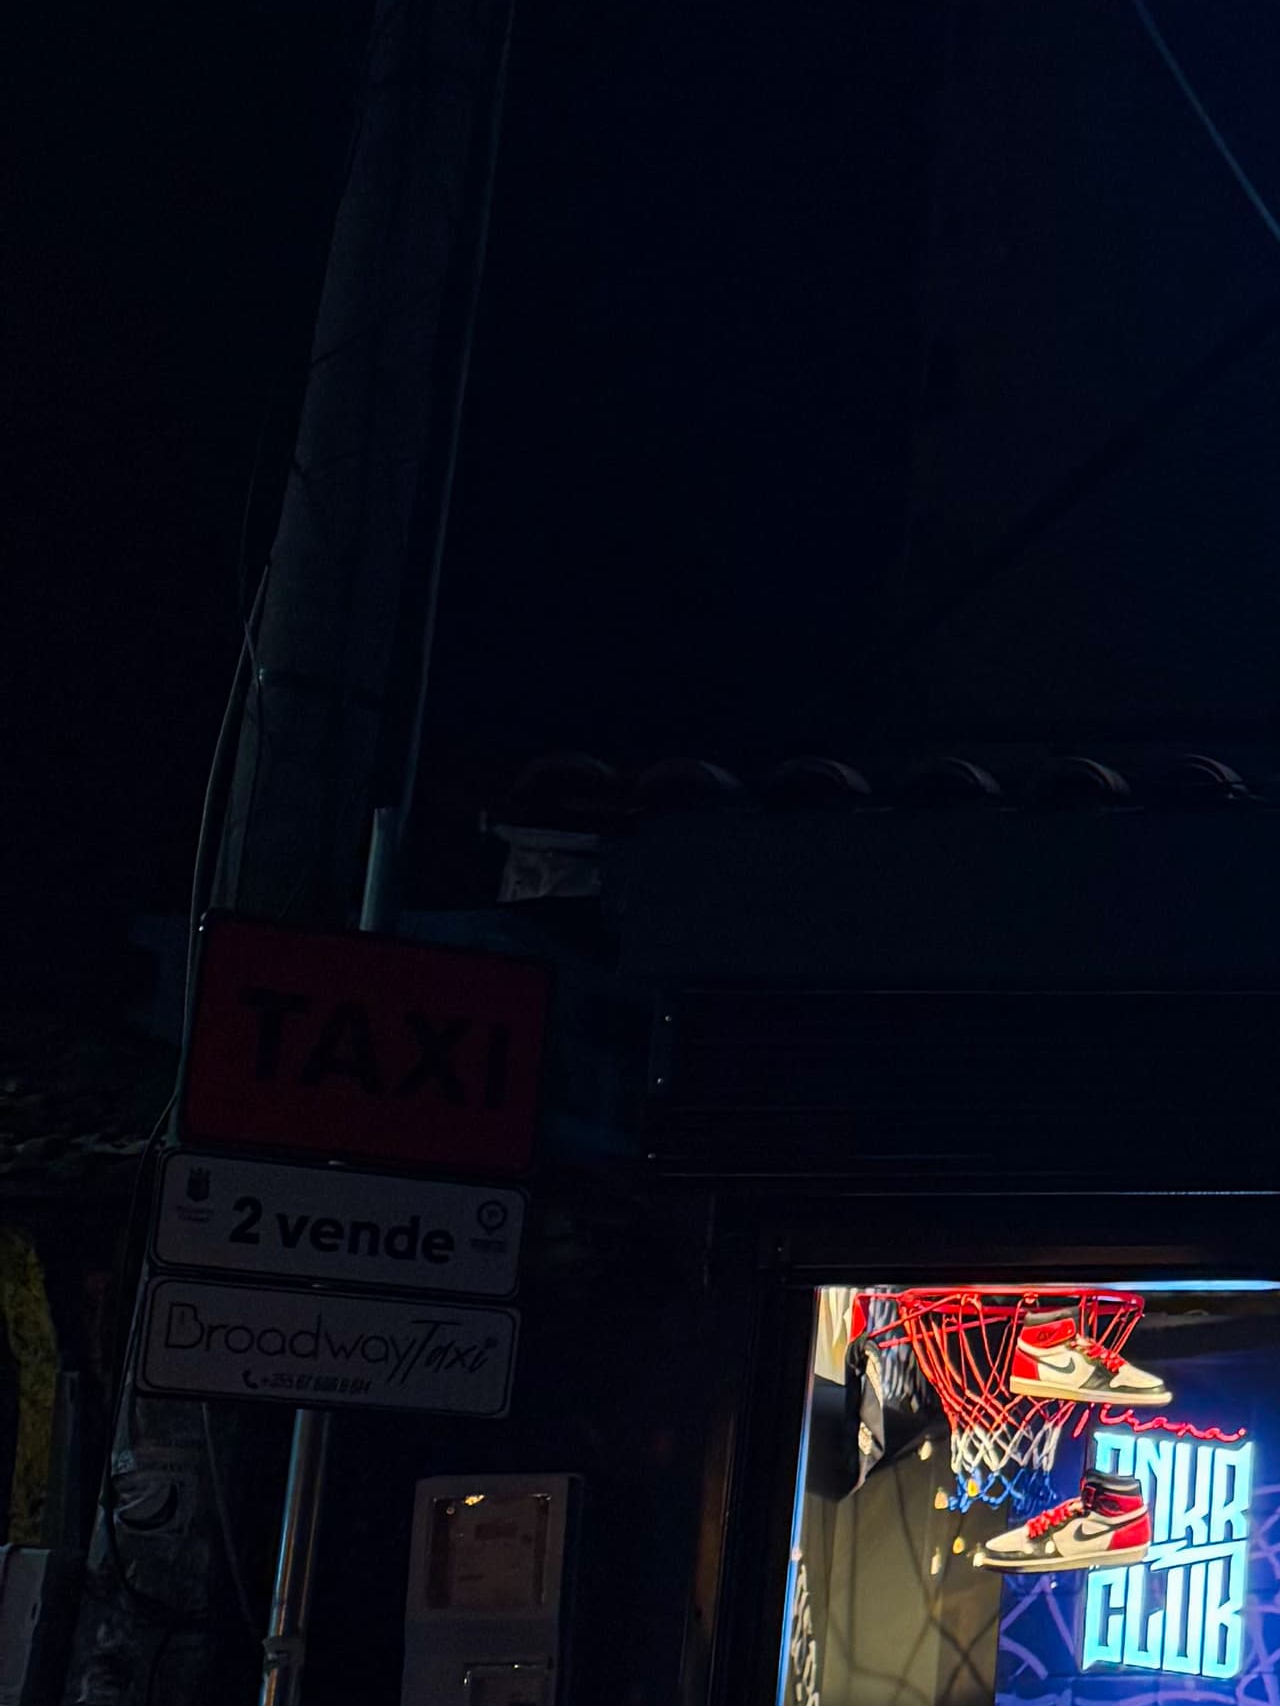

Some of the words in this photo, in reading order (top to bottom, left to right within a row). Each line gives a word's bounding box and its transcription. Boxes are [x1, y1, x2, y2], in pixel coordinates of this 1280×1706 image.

[245, 987, 511, 1108] TAXI
[229, 1196, 263, 1246] 2
[275, 1212, 456, 1264] vende
[1081, 1540, 1249, 1680] CLUB
